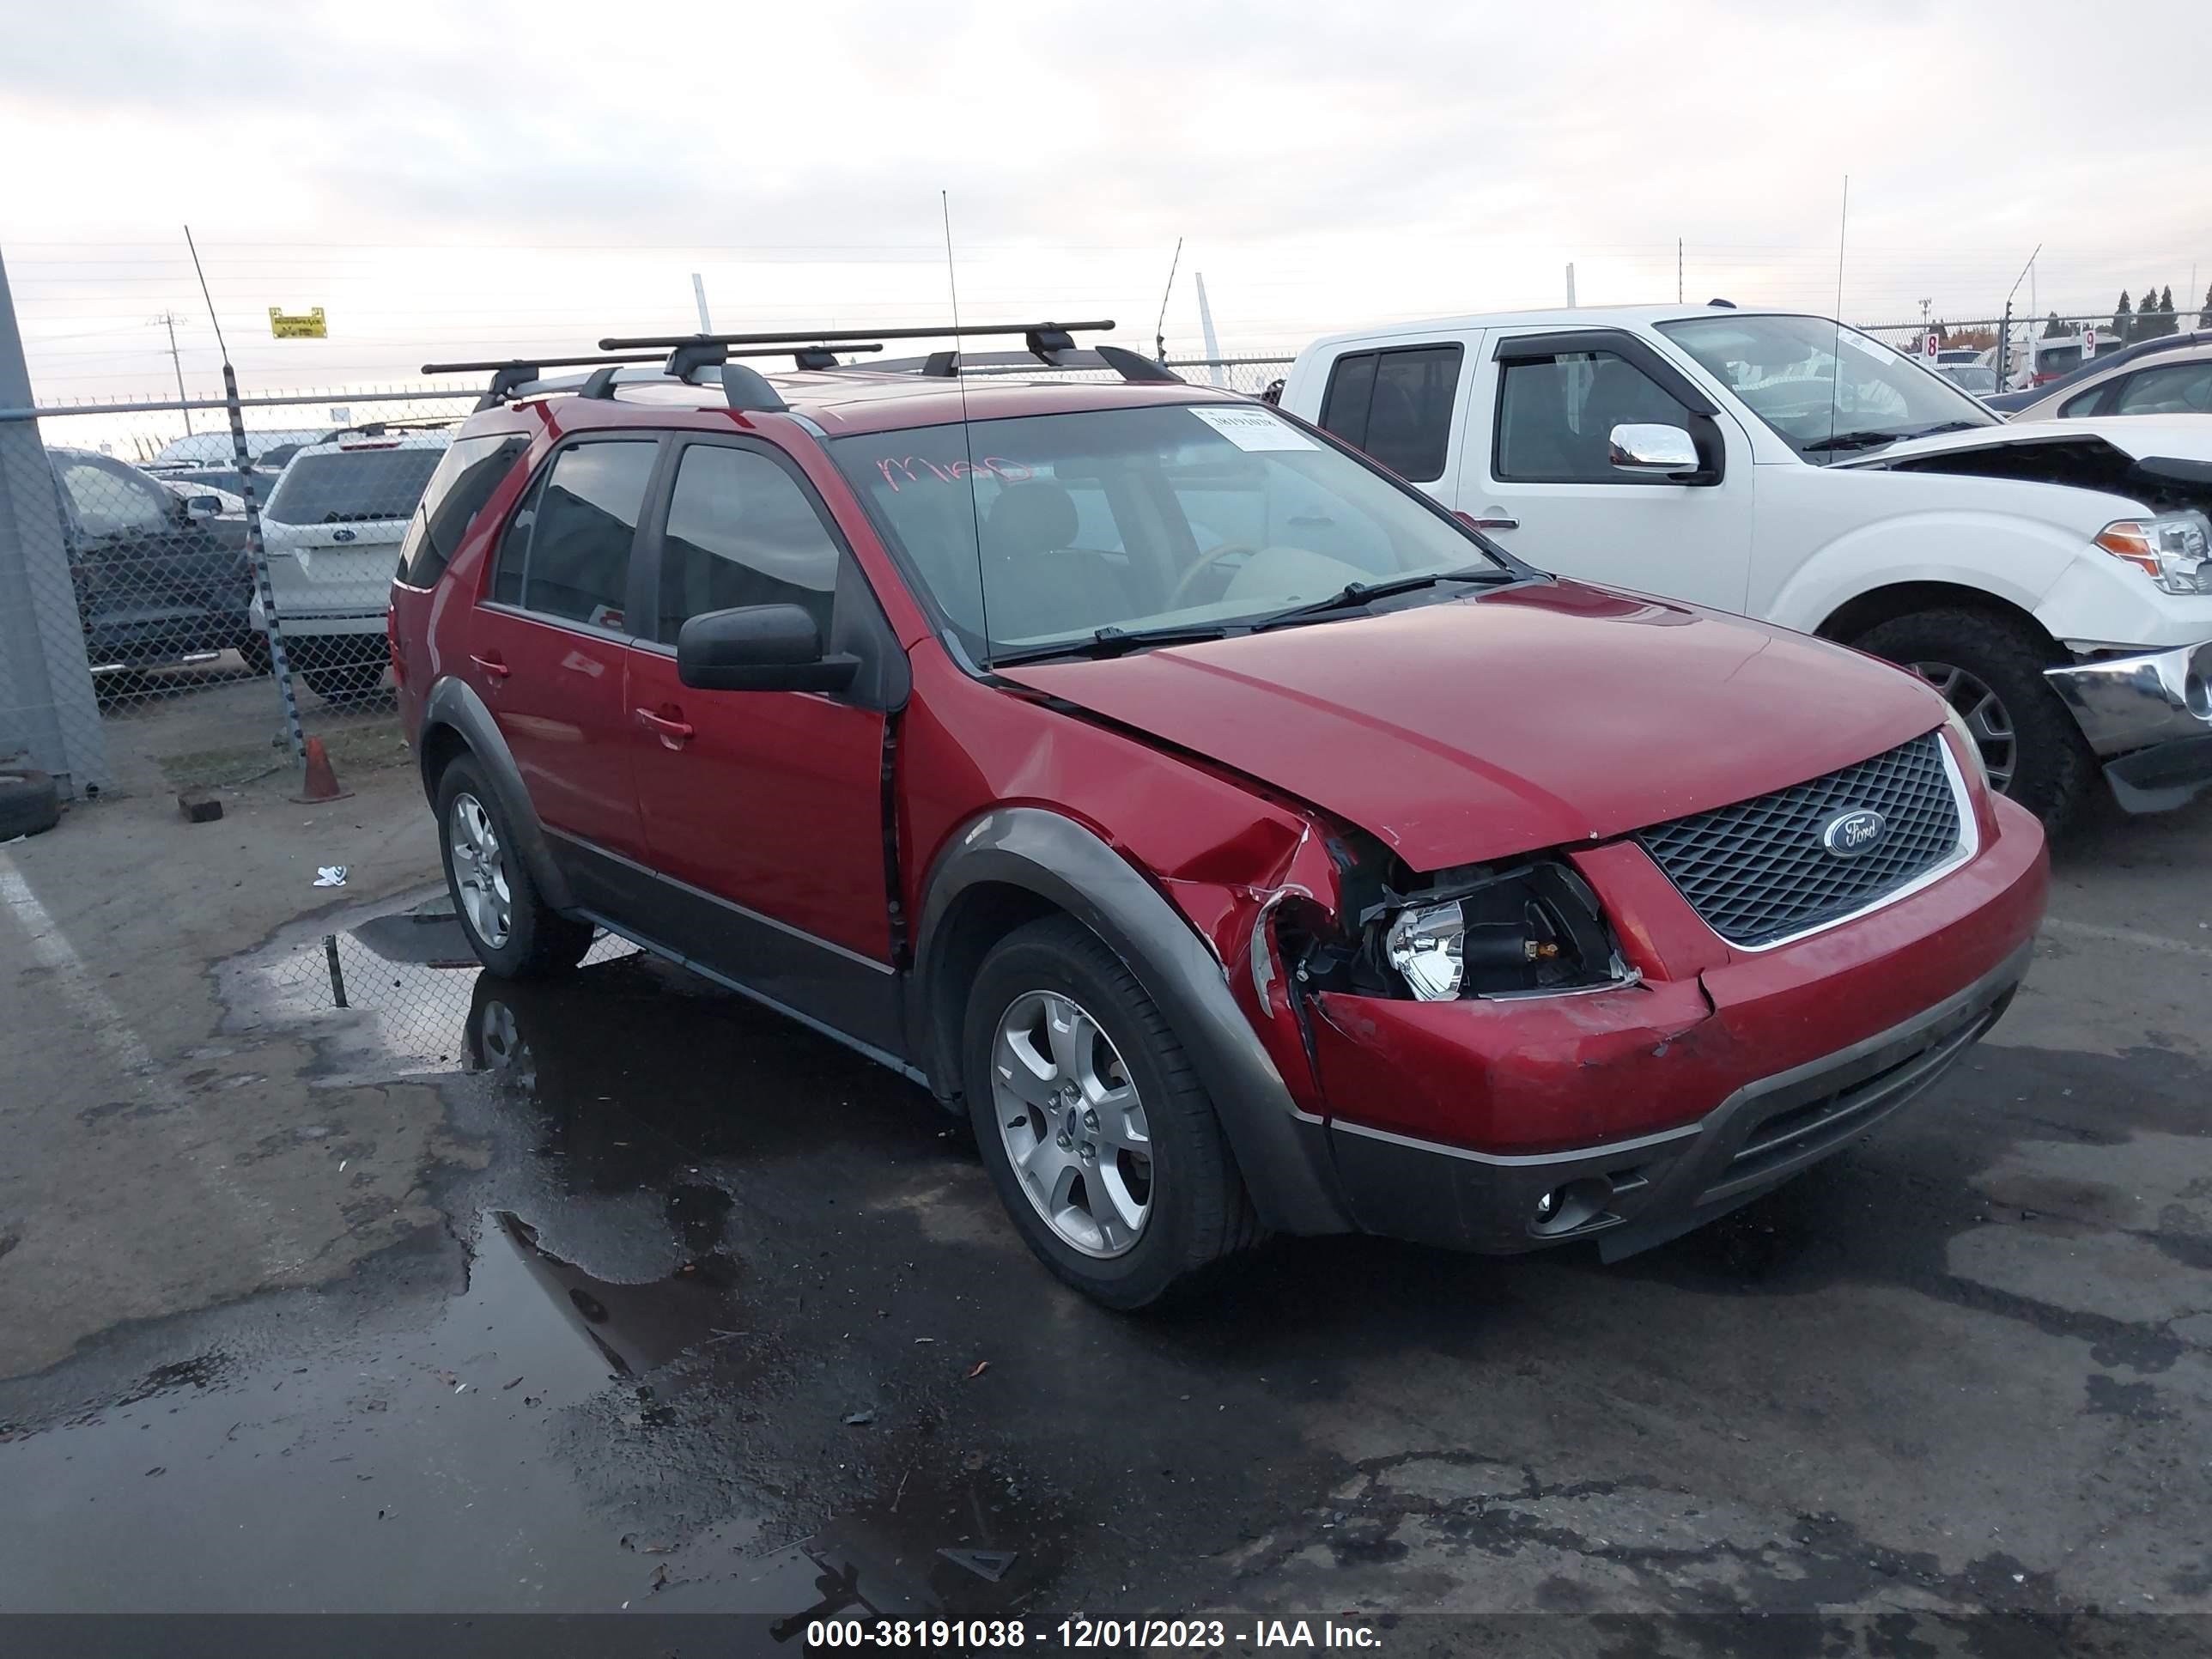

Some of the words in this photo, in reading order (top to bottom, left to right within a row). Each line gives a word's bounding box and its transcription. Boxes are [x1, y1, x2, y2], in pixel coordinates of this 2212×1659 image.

[1928, 336, 1936, 357] 8
[2087, 331, 2094, 351] 9
[1844, 817, 1877, 848] Ford
